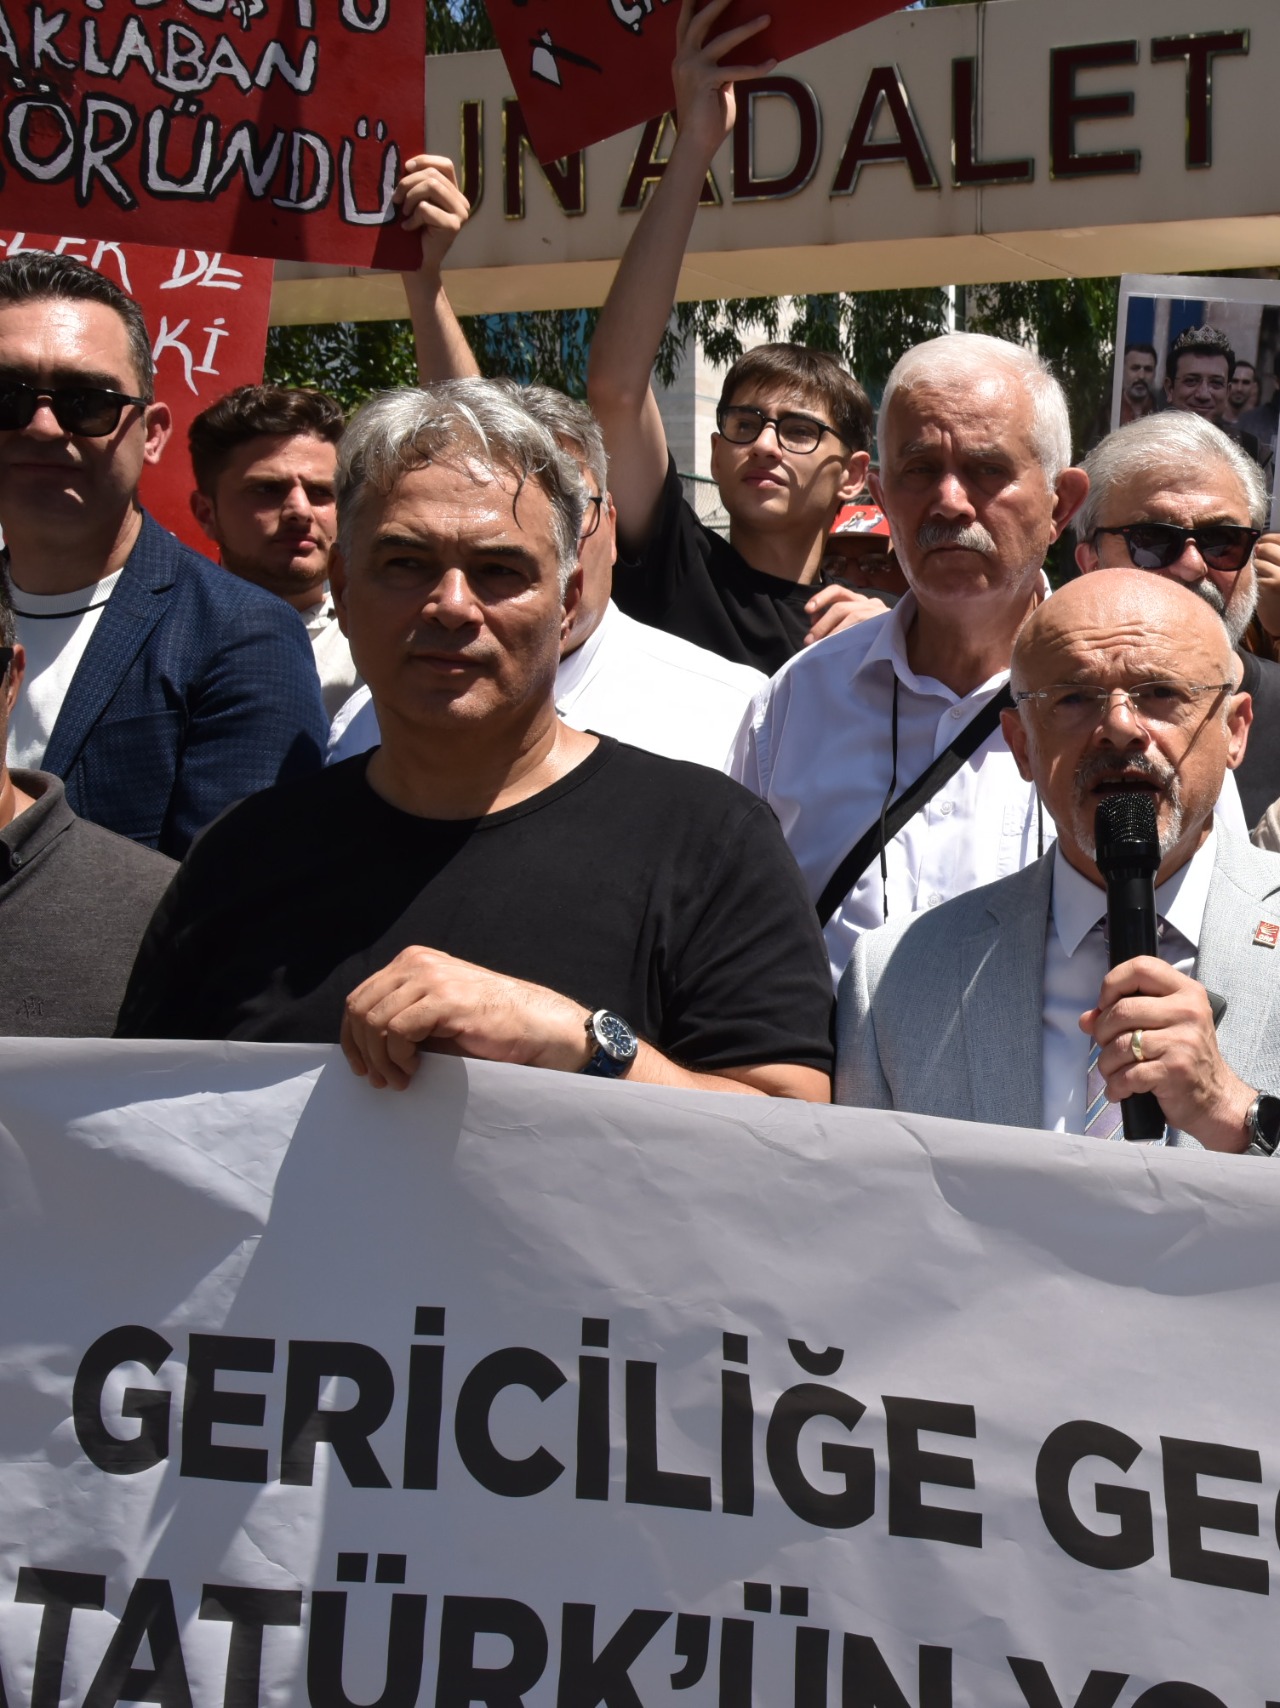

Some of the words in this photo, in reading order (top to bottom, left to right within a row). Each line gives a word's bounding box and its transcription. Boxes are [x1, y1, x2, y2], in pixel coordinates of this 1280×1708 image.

[617, 28, 1251, 213] ADALET
[150, 317, 229, 396] Kİ
[72, 1305, 984, 1549] GERİCİLİĞE
[0, 1551, 953, 1708] TATÜRK'ÜN
